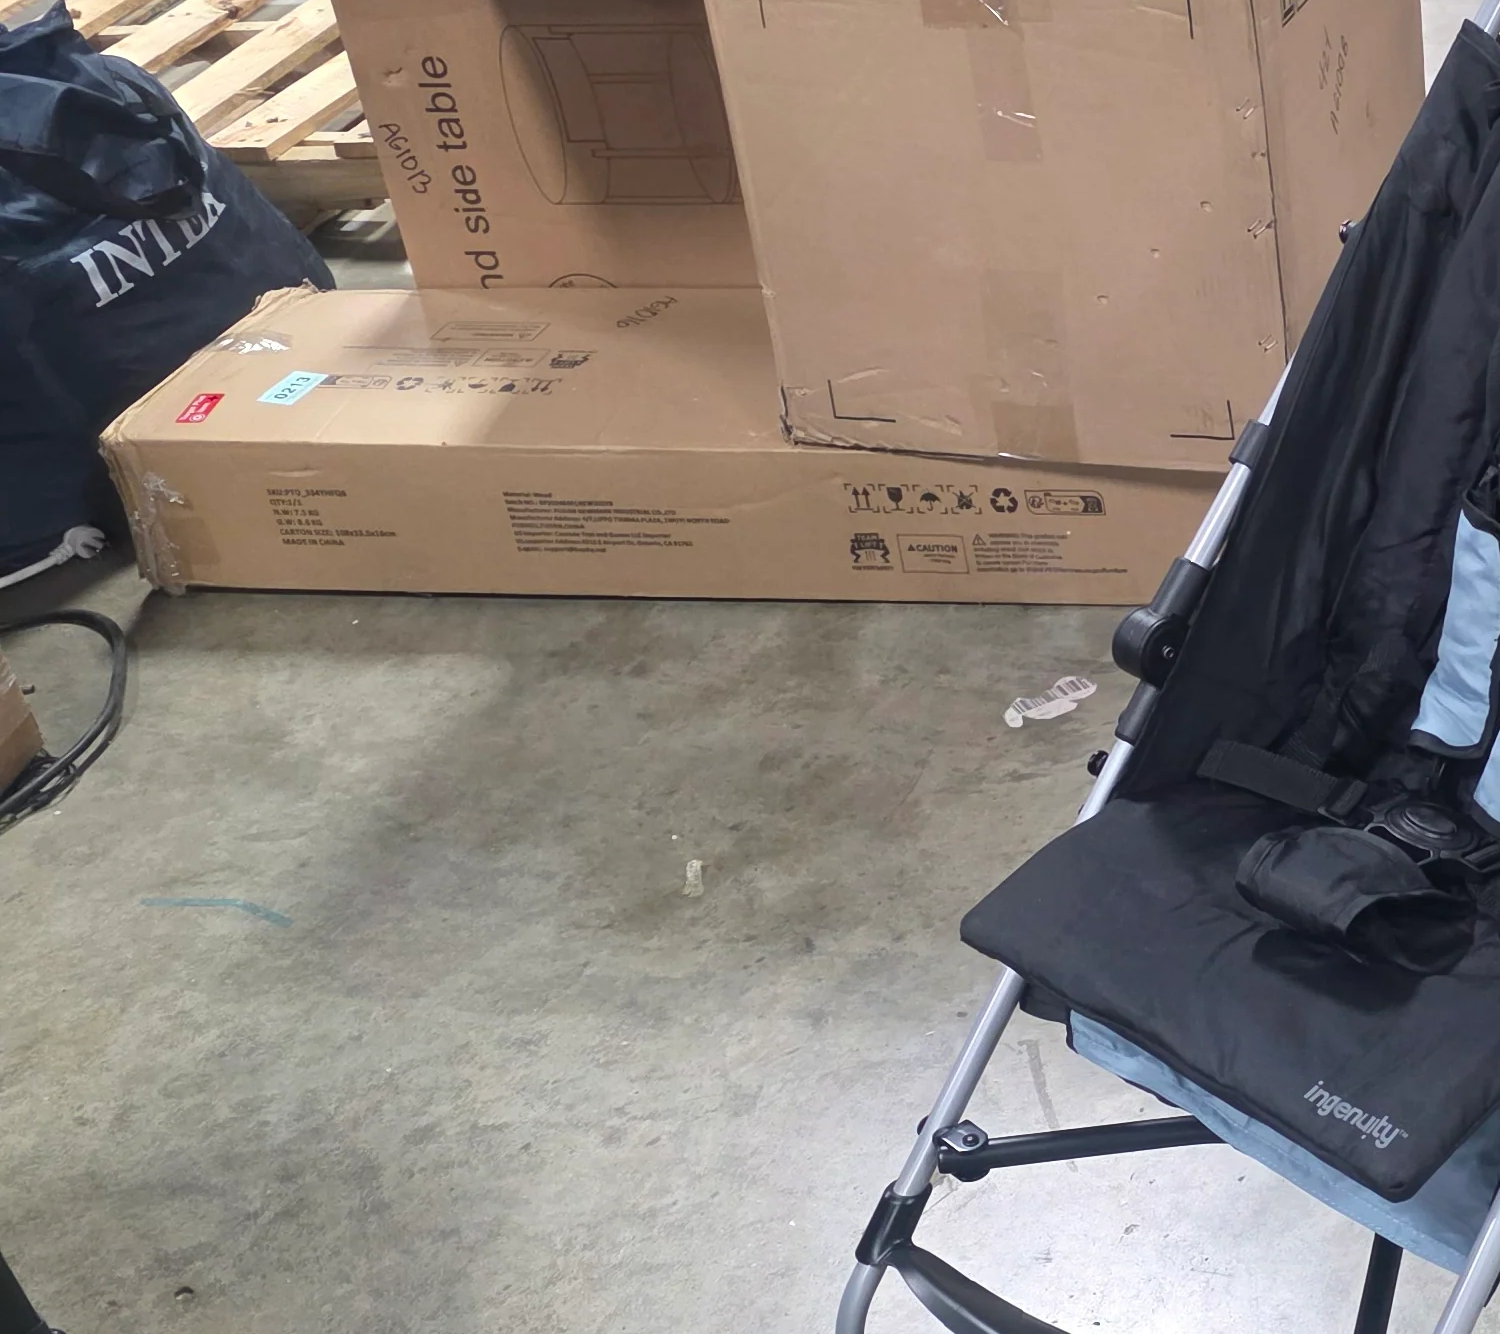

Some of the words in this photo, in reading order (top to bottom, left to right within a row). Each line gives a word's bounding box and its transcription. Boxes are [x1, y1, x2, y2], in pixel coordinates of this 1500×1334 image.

[418, 55, 468, 153] table
[451, 163, 491, 235] side
[274, 376, 310, 400] 0213
[917, 544, 958, 554] CAUTION
[1304, 1080, 1401, 1149] ingenuity
